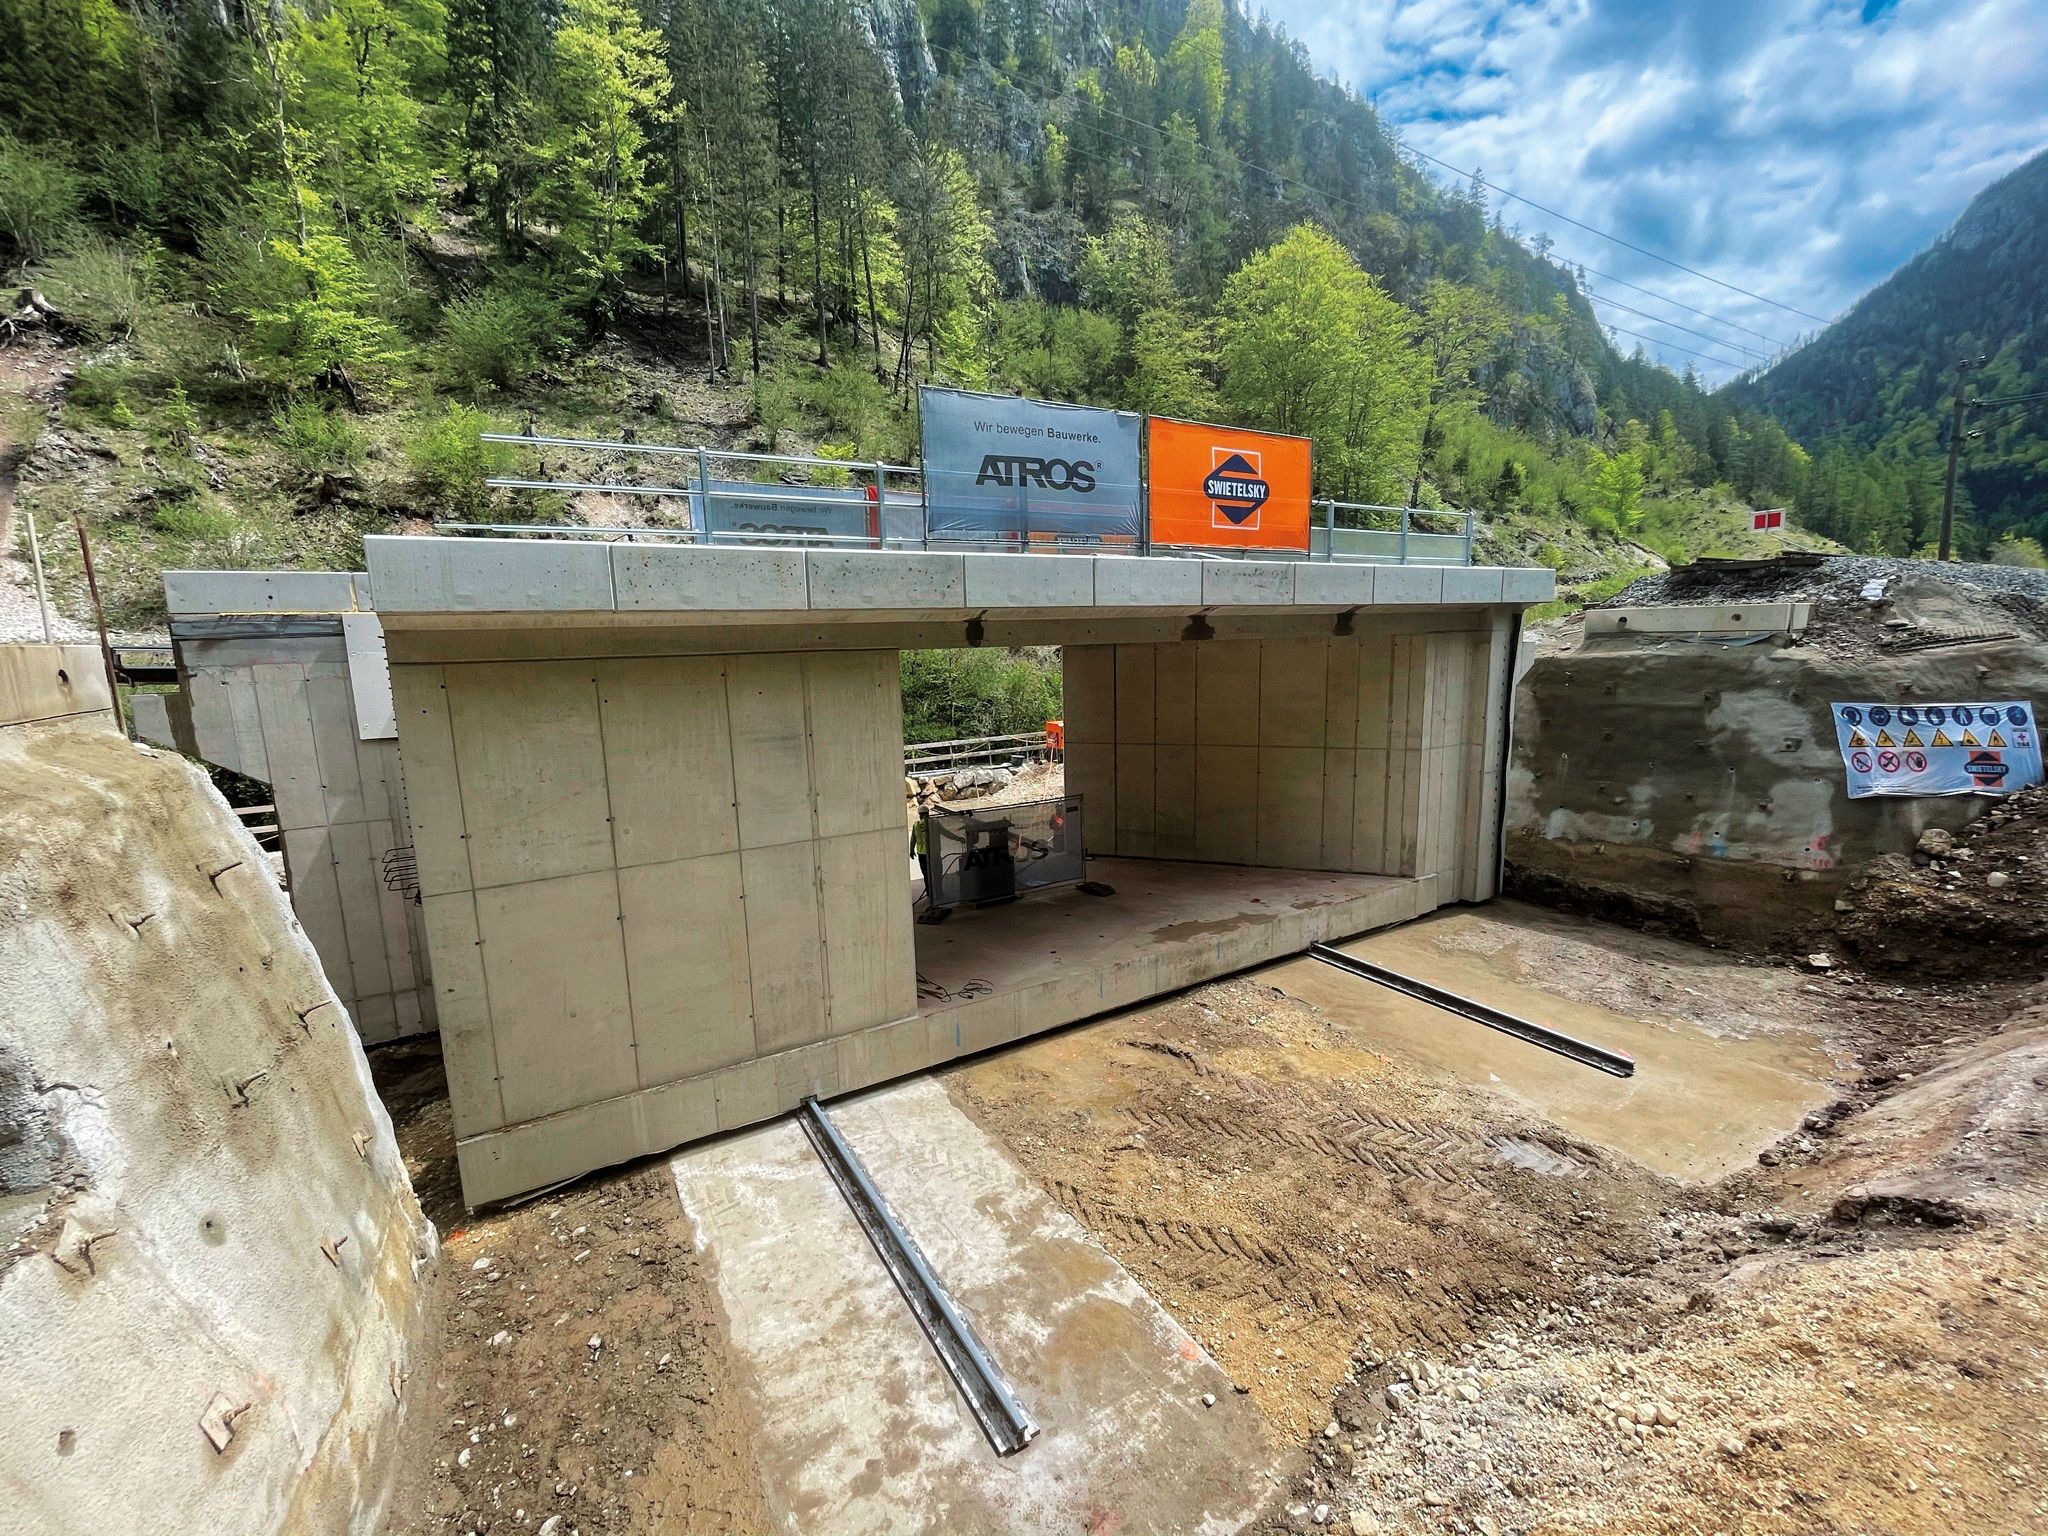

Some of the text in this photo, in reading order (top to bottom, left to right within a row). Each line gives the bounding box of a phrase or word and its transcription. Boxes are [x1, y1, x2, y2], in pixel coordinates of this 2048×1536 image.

[974, 420, 1101, 443] Wir bewegen Bauwerke.
[1207, 479, 1266, 498] SWIETELSKY
